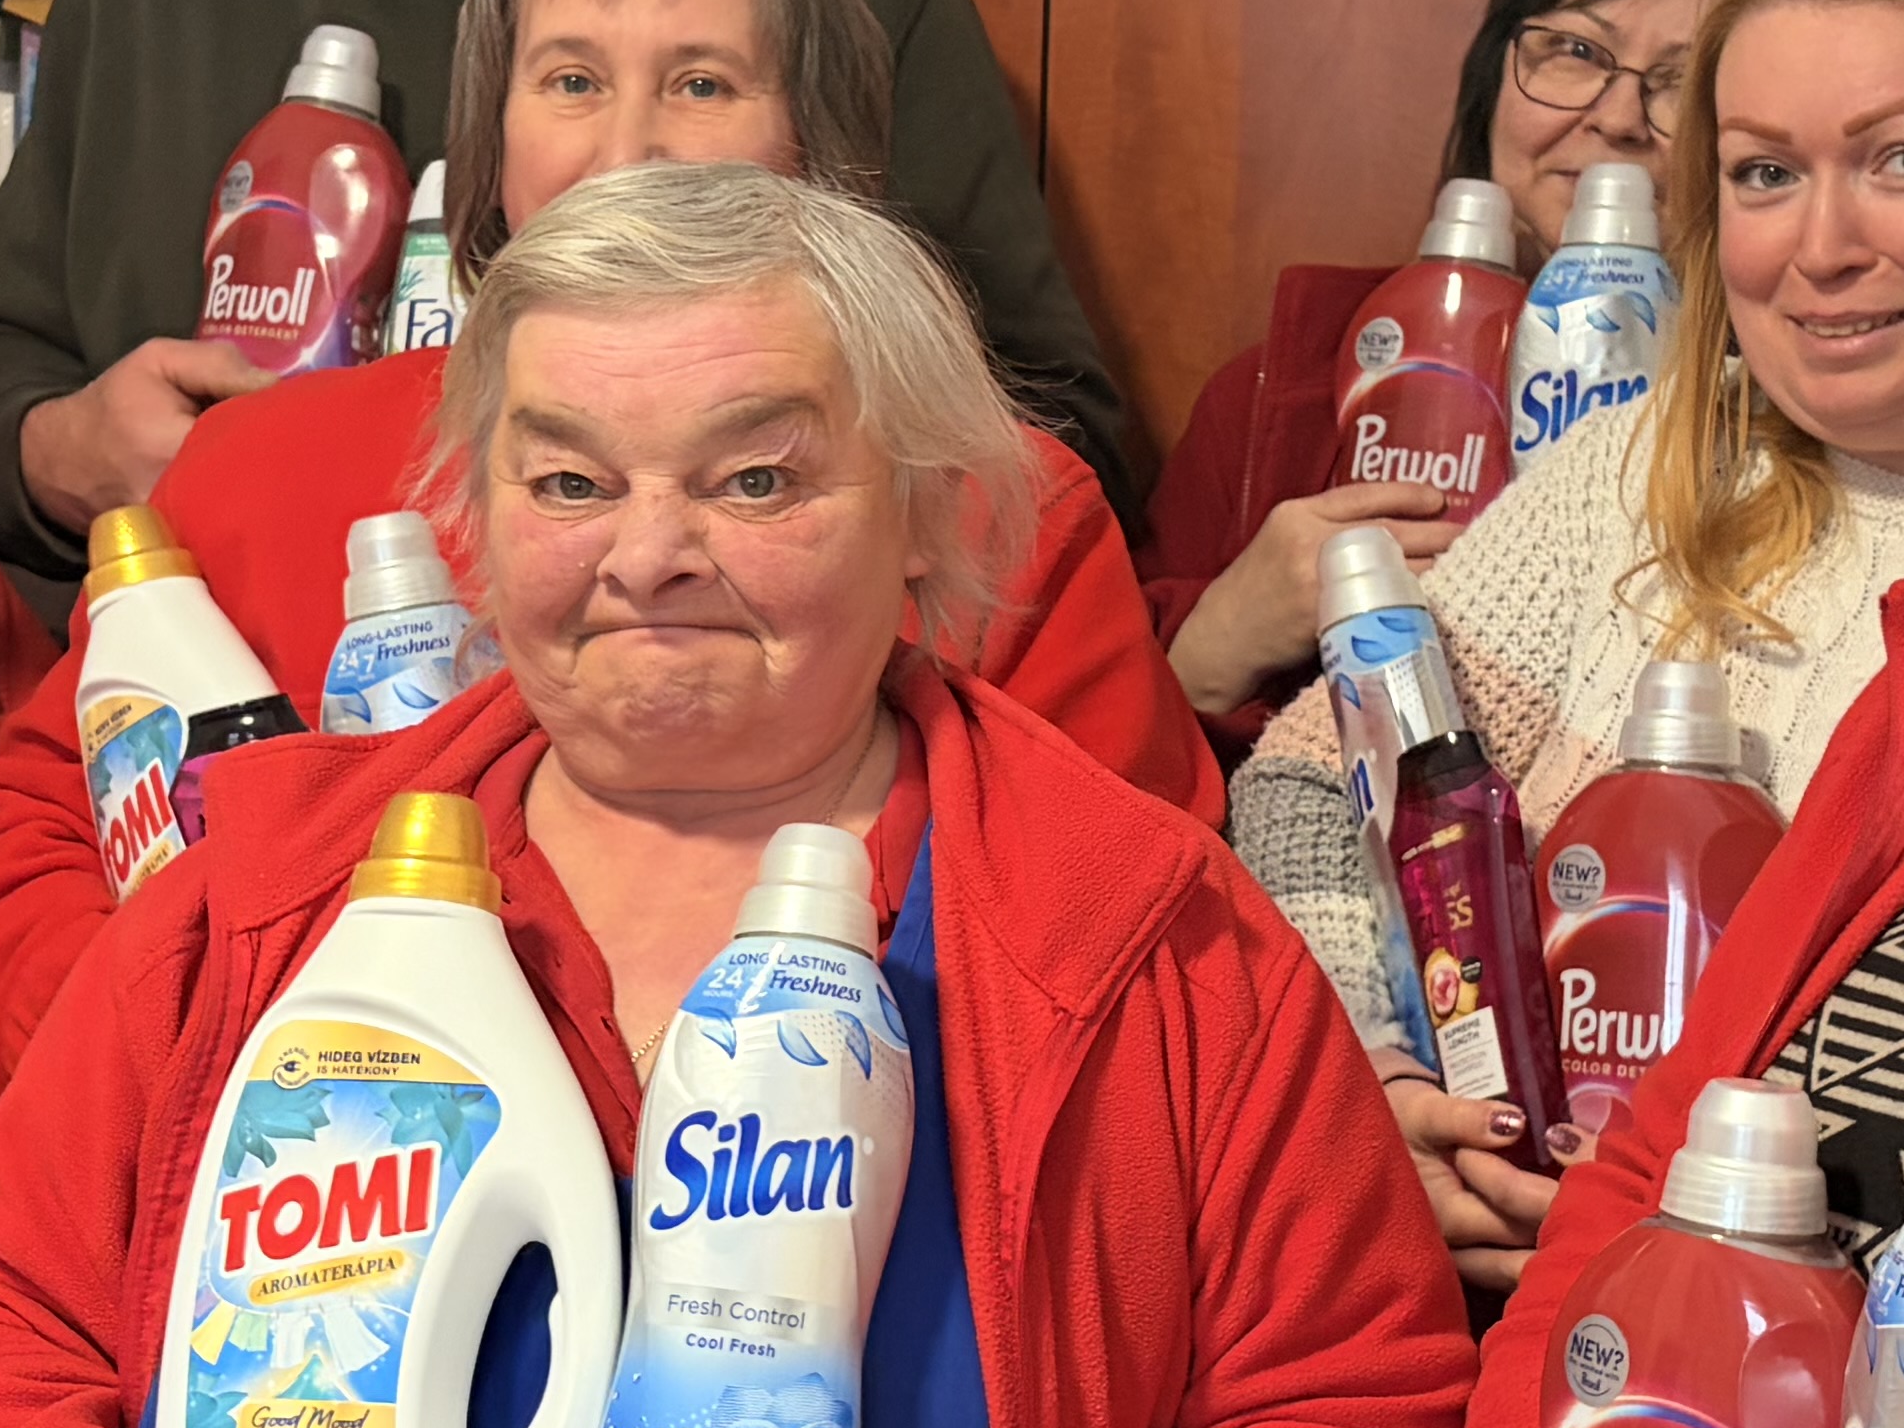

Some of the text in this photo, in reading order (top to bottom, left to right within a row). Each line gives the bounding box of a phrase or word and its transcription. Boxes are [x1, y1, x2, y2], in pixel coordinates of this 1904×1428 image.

[204, 254, 316, 326] Perwoll
[406, 298, 455, 350] Fa
[1351, 414, 1486, 493] Perwoll
[346, 620, 434, 651] LONG-LASTING
[377, 636, 451, 661] Freshness
[337, 652, 375, 673] 24 7
[1553, 861, 1601, 883] NEW?
[708, 967, 744, 989] 24
[769, 969, 862, 1003] Freshness
[317, 1065, 400, 1076] IS HATÉKONY
[318, 1049, 421, 1065] HIDEG VÍZBEN
[1562, 1058, 1612, 1075] COLOR
[649, 1109, 854, 1231] Silan
[220, 1147, 434, 1273] TOMI
[256, 1255, 397, 1298] AROMATERÁPIA
[667, 1293, 807, 1330] Fresh Control
[686, 1333, 776, 1359] Cool Fresh
[1570, 1332, 1624, 1371] NEW?
